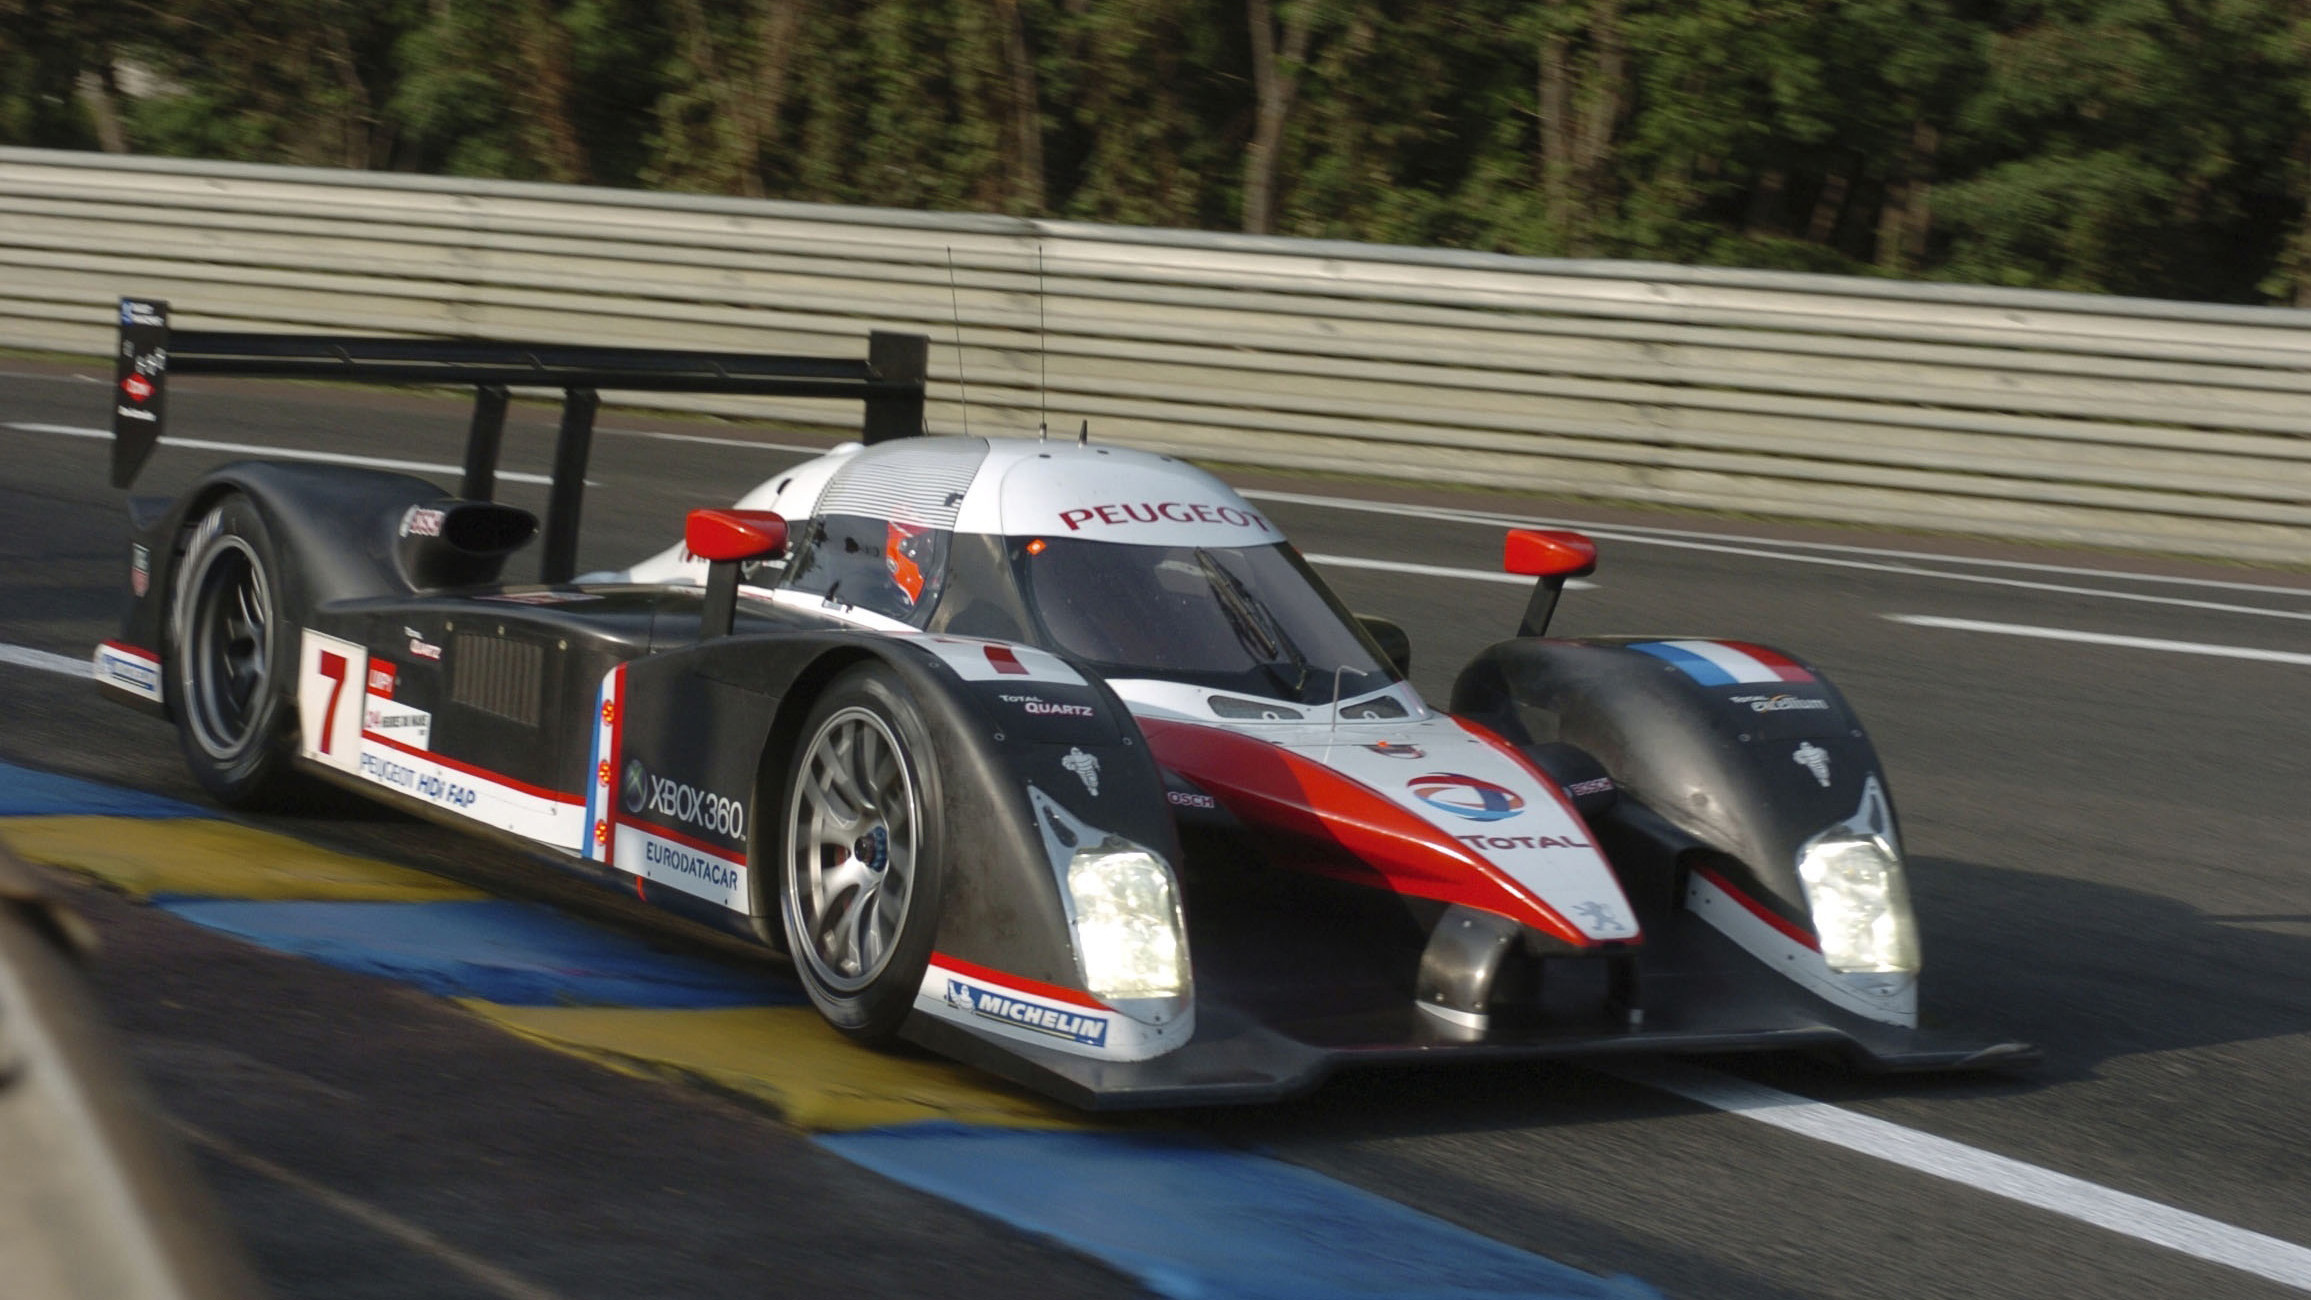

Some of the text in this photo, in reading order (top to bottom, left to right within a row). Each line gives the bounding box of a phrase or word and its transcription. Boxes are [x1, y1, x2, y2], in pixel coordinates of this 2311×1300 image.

[1058, 502, 1270, 532] PEUGEOT
[319, 649, 348, 755] 7
[998, 694, 1043, 703] TOTAL
[1025, 702, 1094, 717] QUARTZ
[361, 751, 416, 789] PEUGEOT
[446, 783, 477, 808] FAP
[648, 774, 705, 827] XBOX
[704, 792, 744, 840] 360
[1167, 791, 1215, 809] OSCH
[1455, 834, 1593, 850] TOTAL
[646, 841, 738, 891] EURODATACAR
[977, 993, 1105, 1039] MICHELIN
